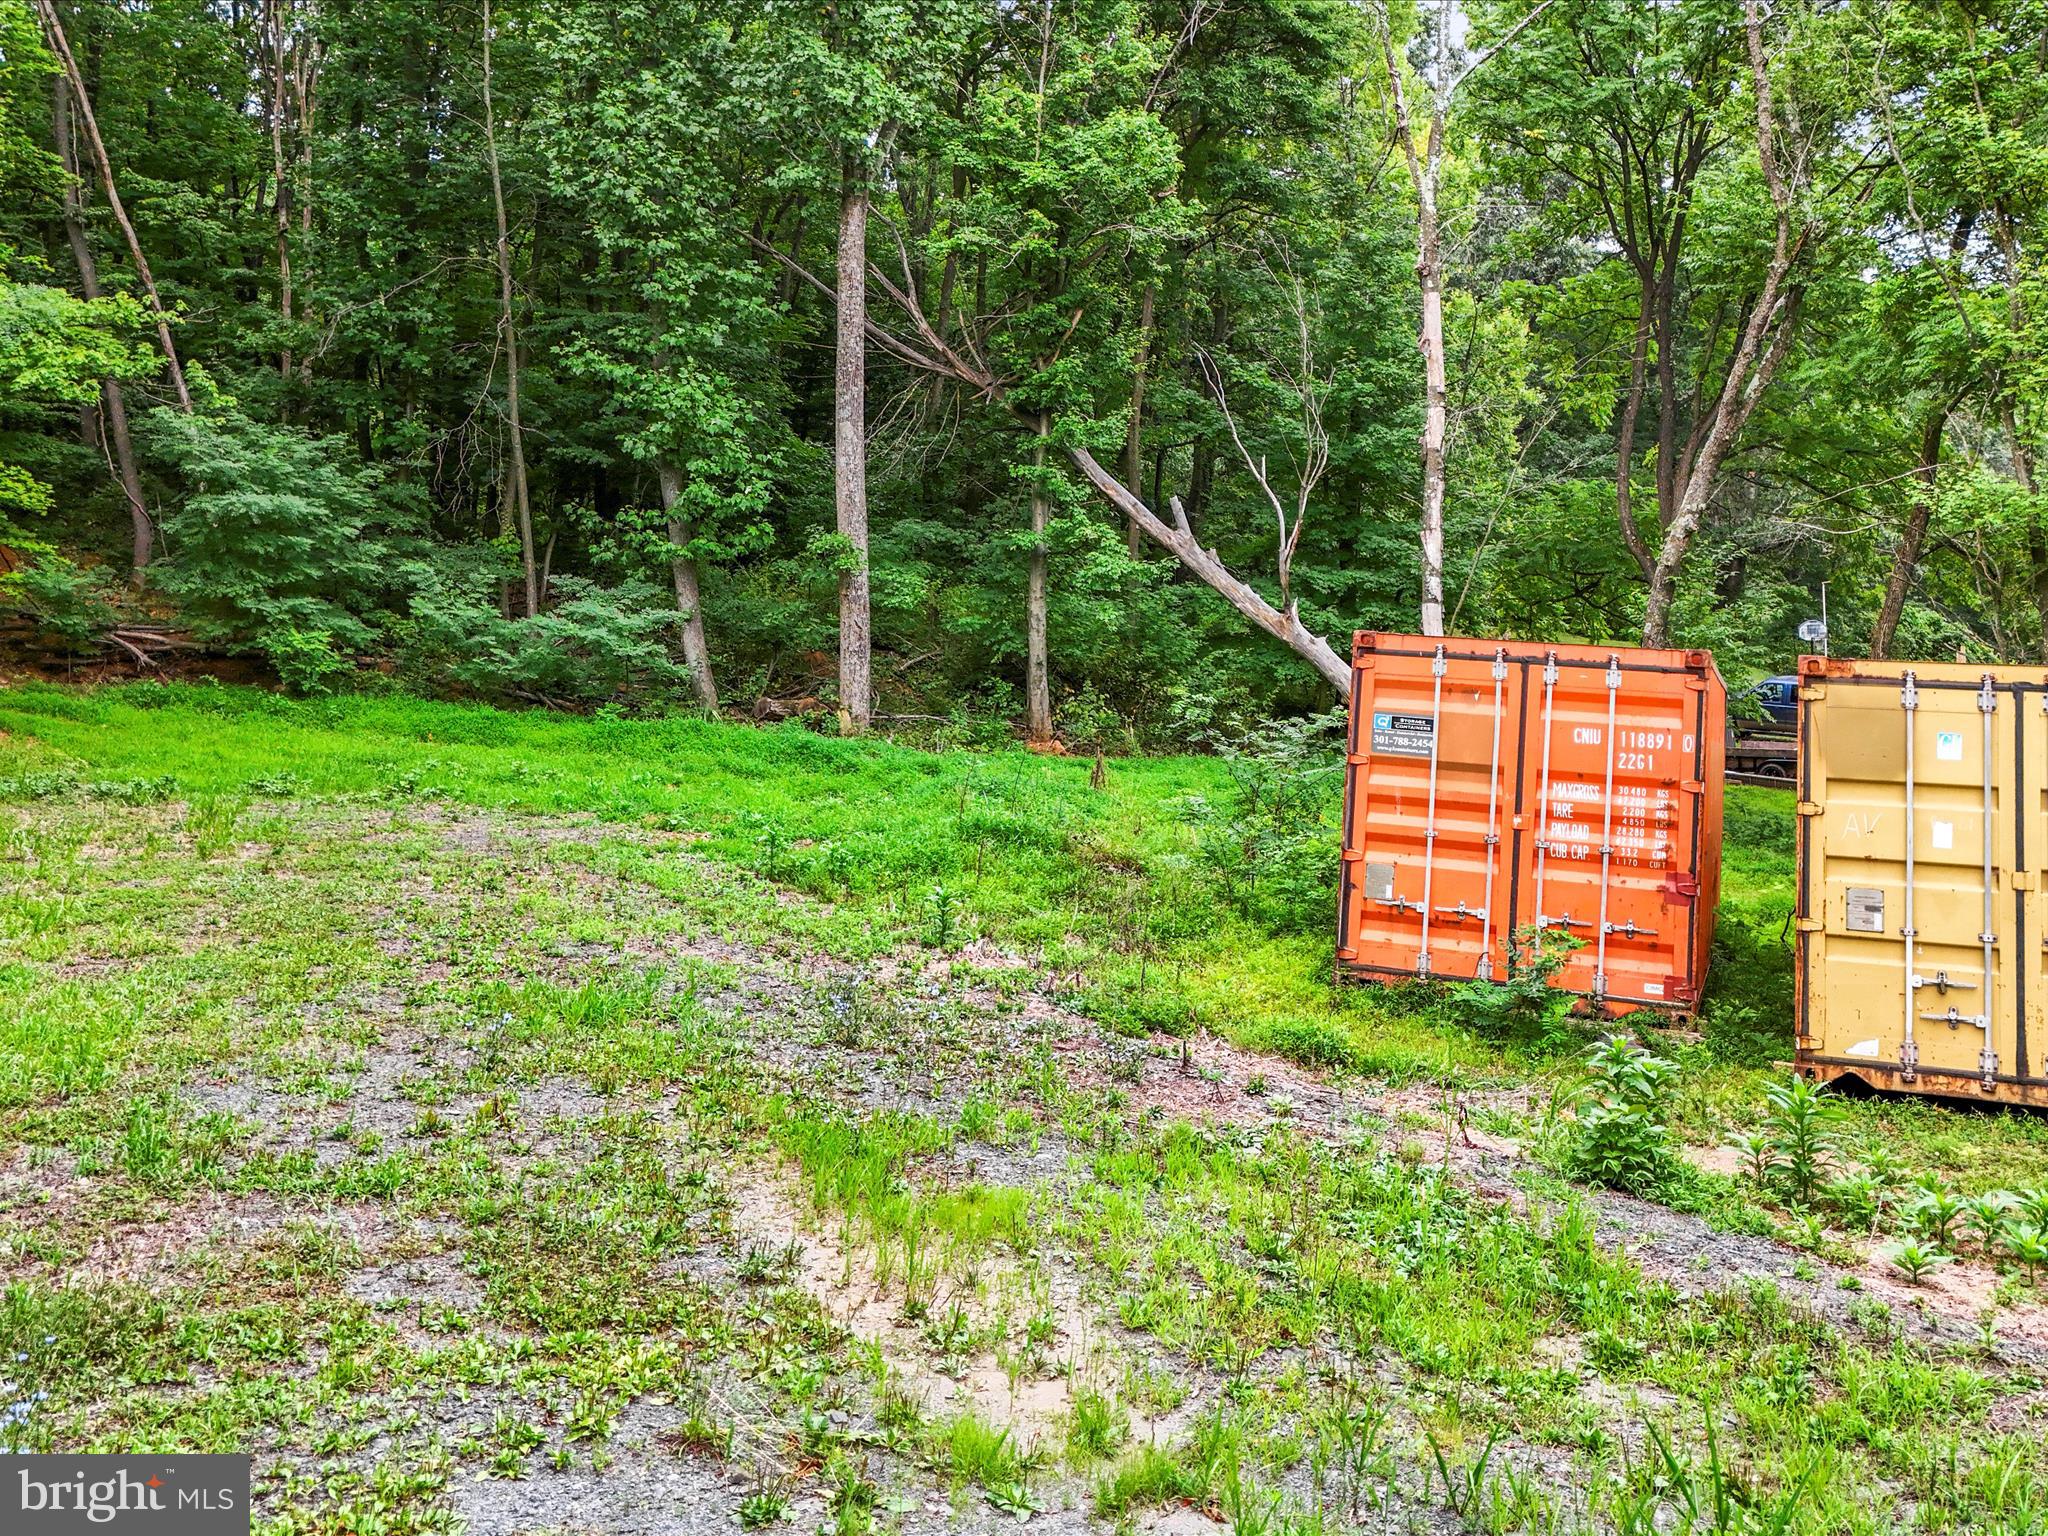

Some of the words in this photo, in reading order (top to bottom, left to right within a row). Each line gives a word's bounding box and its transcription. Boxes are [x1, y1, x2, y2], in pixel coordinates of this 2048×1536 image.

[1373, 734, 1433, 748] 301-788-2454
[1574, 728, 1601, 745] CNIU
[1621, 731, 1672, 750] 118891
[1618, 753, 1653, 771] 22G1
[1552, 802, 1574, 818] TARE
[1550, 822, 1590, 840] PAYLOAD
[1654, 830, 1668, 840] KGS
